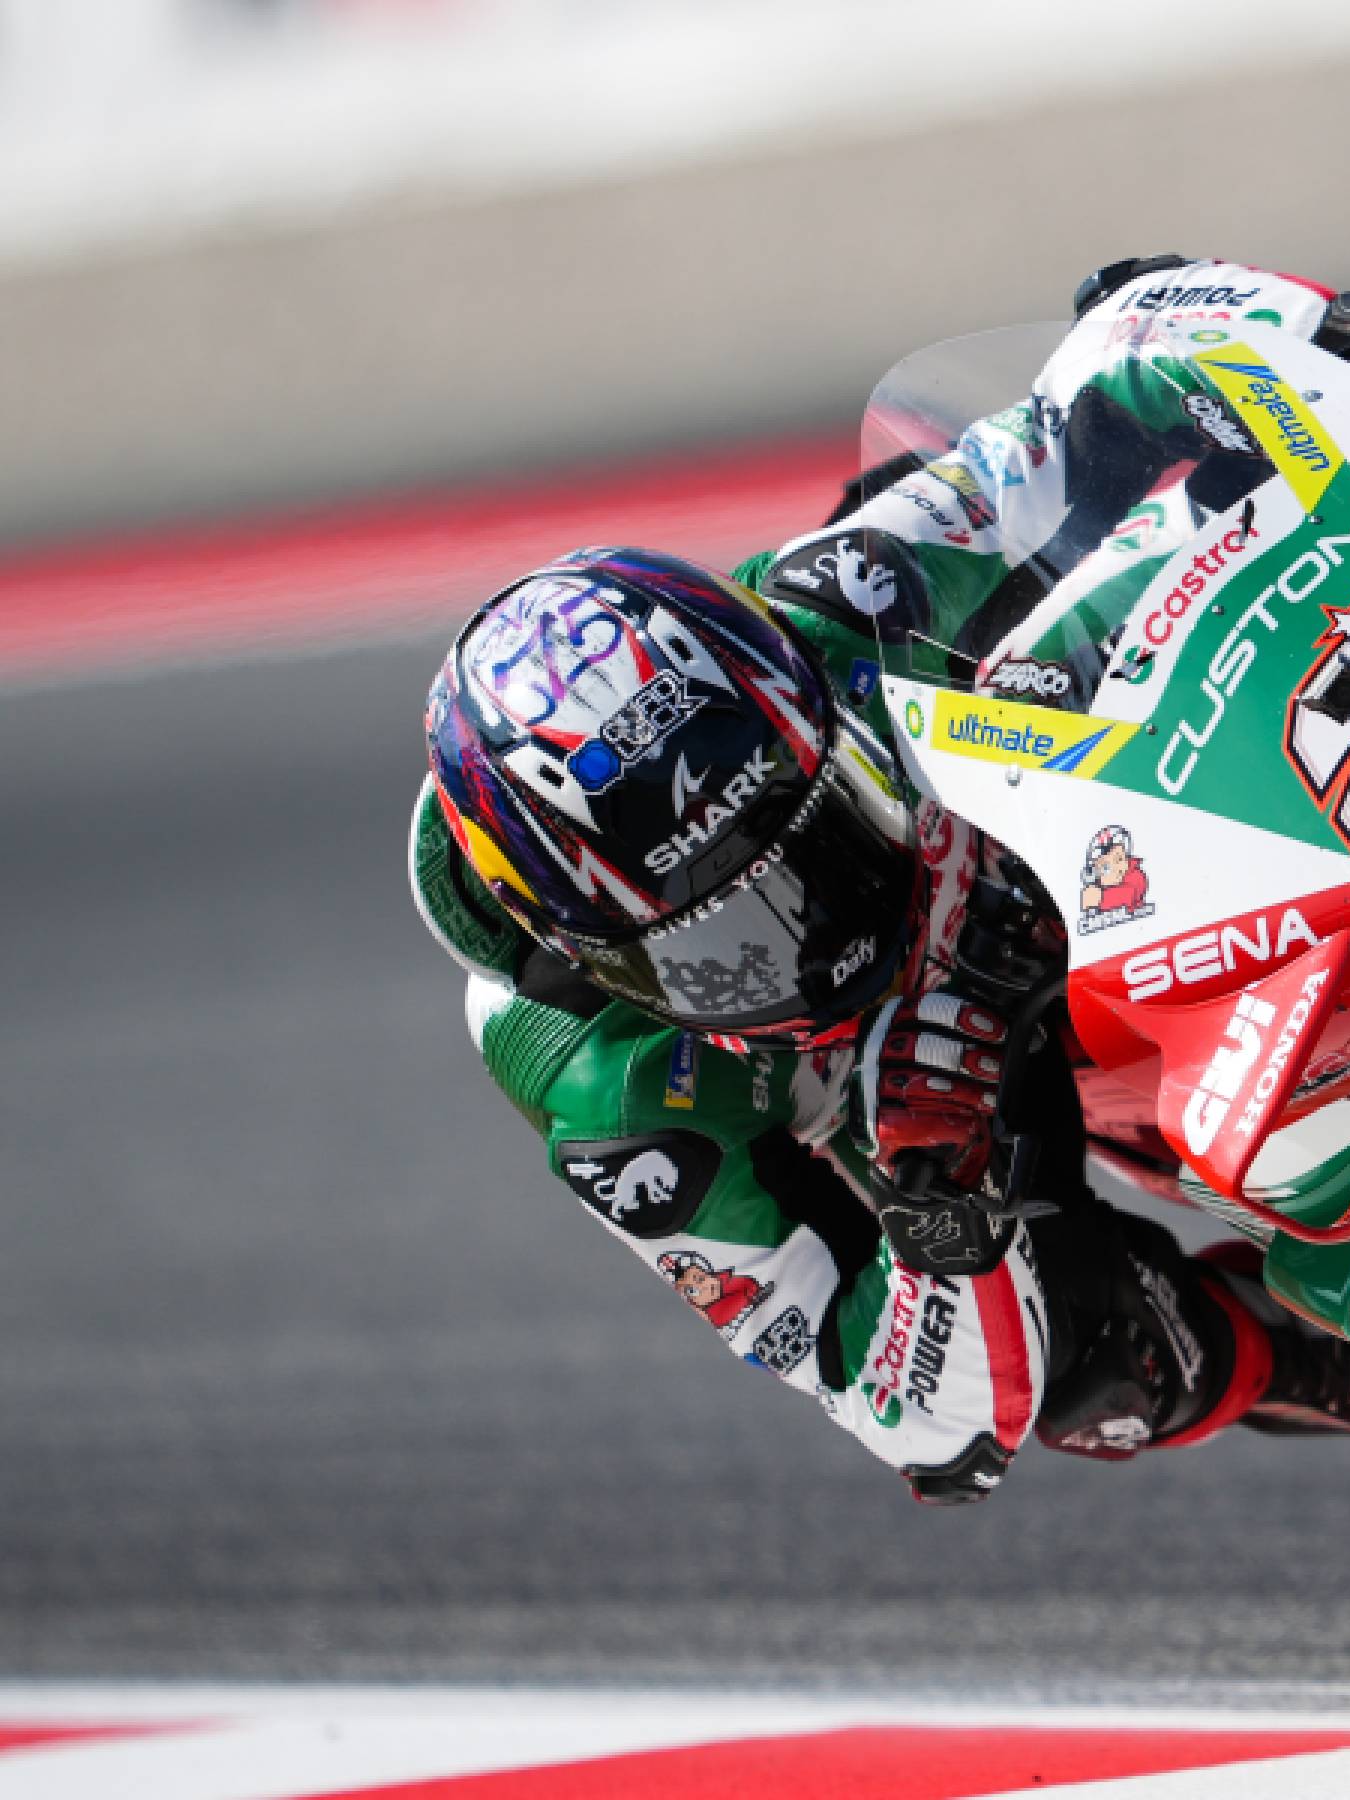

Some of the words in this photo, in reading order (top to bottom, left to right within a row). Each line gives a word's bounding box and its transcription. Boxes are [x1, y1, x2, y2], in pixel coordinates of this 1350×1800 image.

[1247, 382, 1331, 473] ultimate
[946, 712, 1055, 759] ultimate
[643, 744, 777, 875] SHARK
[731, 842, 784, 891] YOU
[1121, 907, 1331, 1002] SENA
[1182, 991, 1278, 1157] GIVI
[1237, 968, 1330, 1135] HONDA
